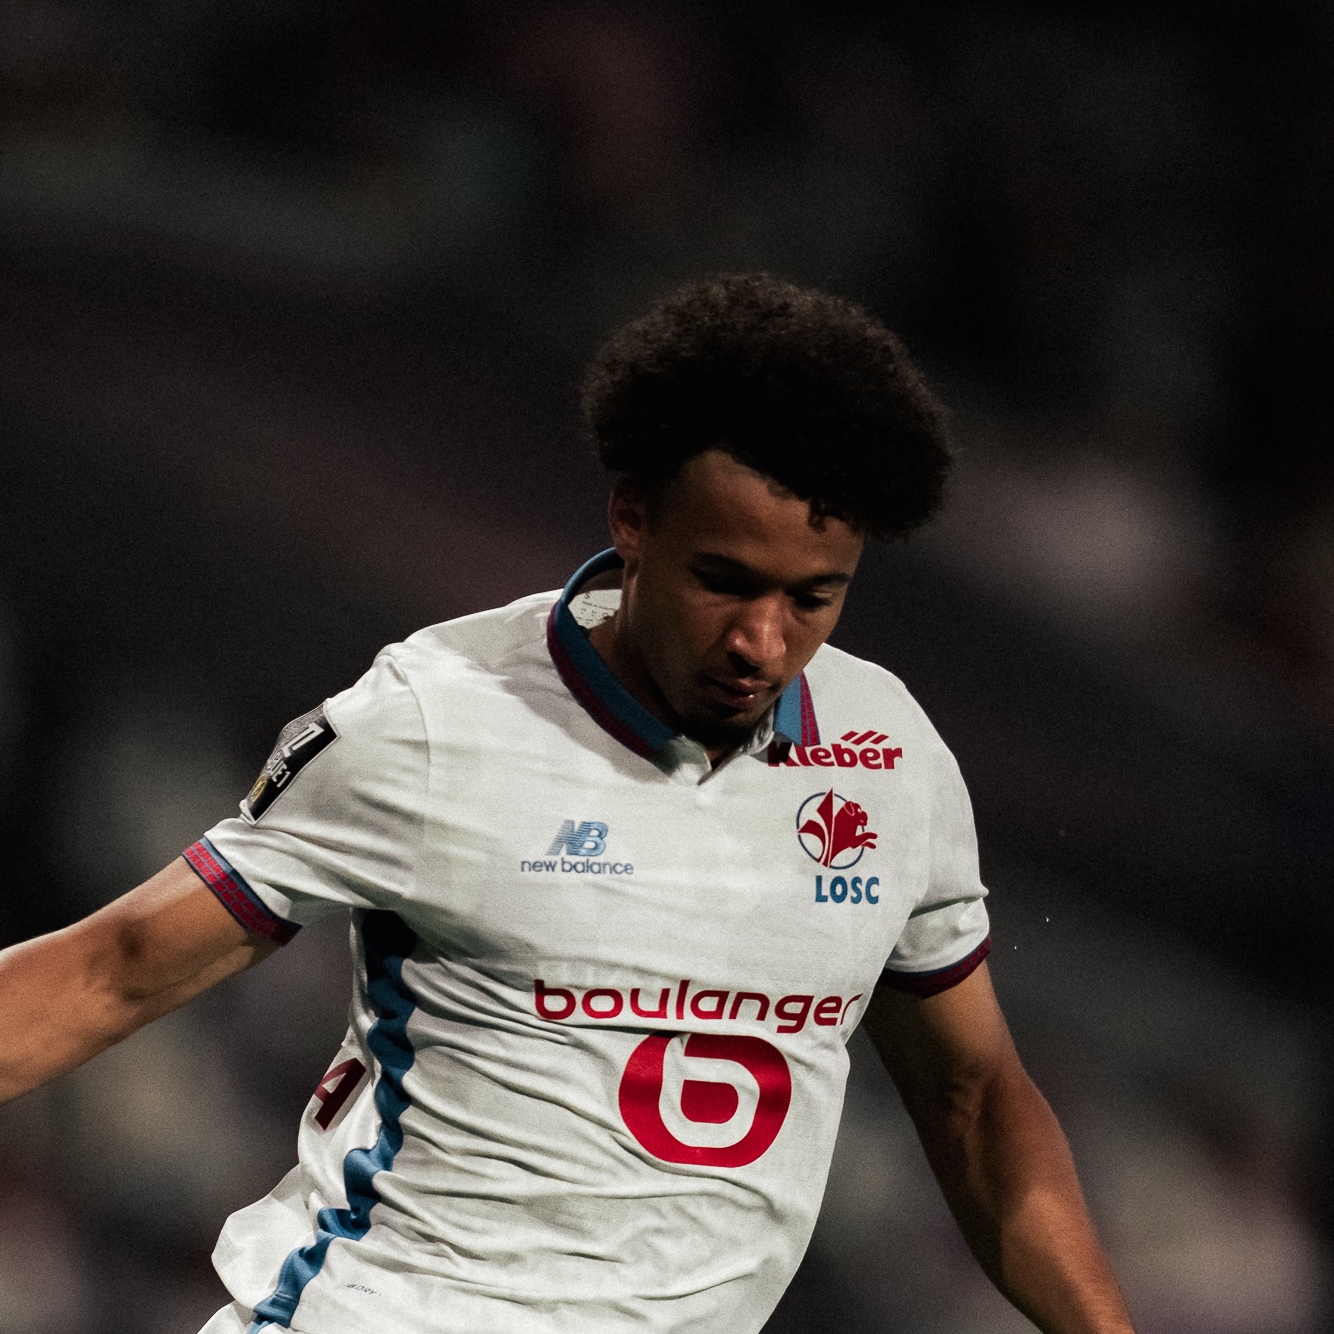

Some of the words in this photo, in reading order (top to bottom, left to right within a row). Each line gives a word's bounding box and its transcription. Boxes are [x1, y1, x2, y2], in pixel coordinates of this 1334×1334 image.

[767, 739, 903, 770] Kleber
[544, 819, 609, 857] NB
[520, 859, 558, 873] new
[561, 857, 634, 875] balance
[814, 874, 880, 904] LOSC
[534, 979, 864, 1034] boulanger
